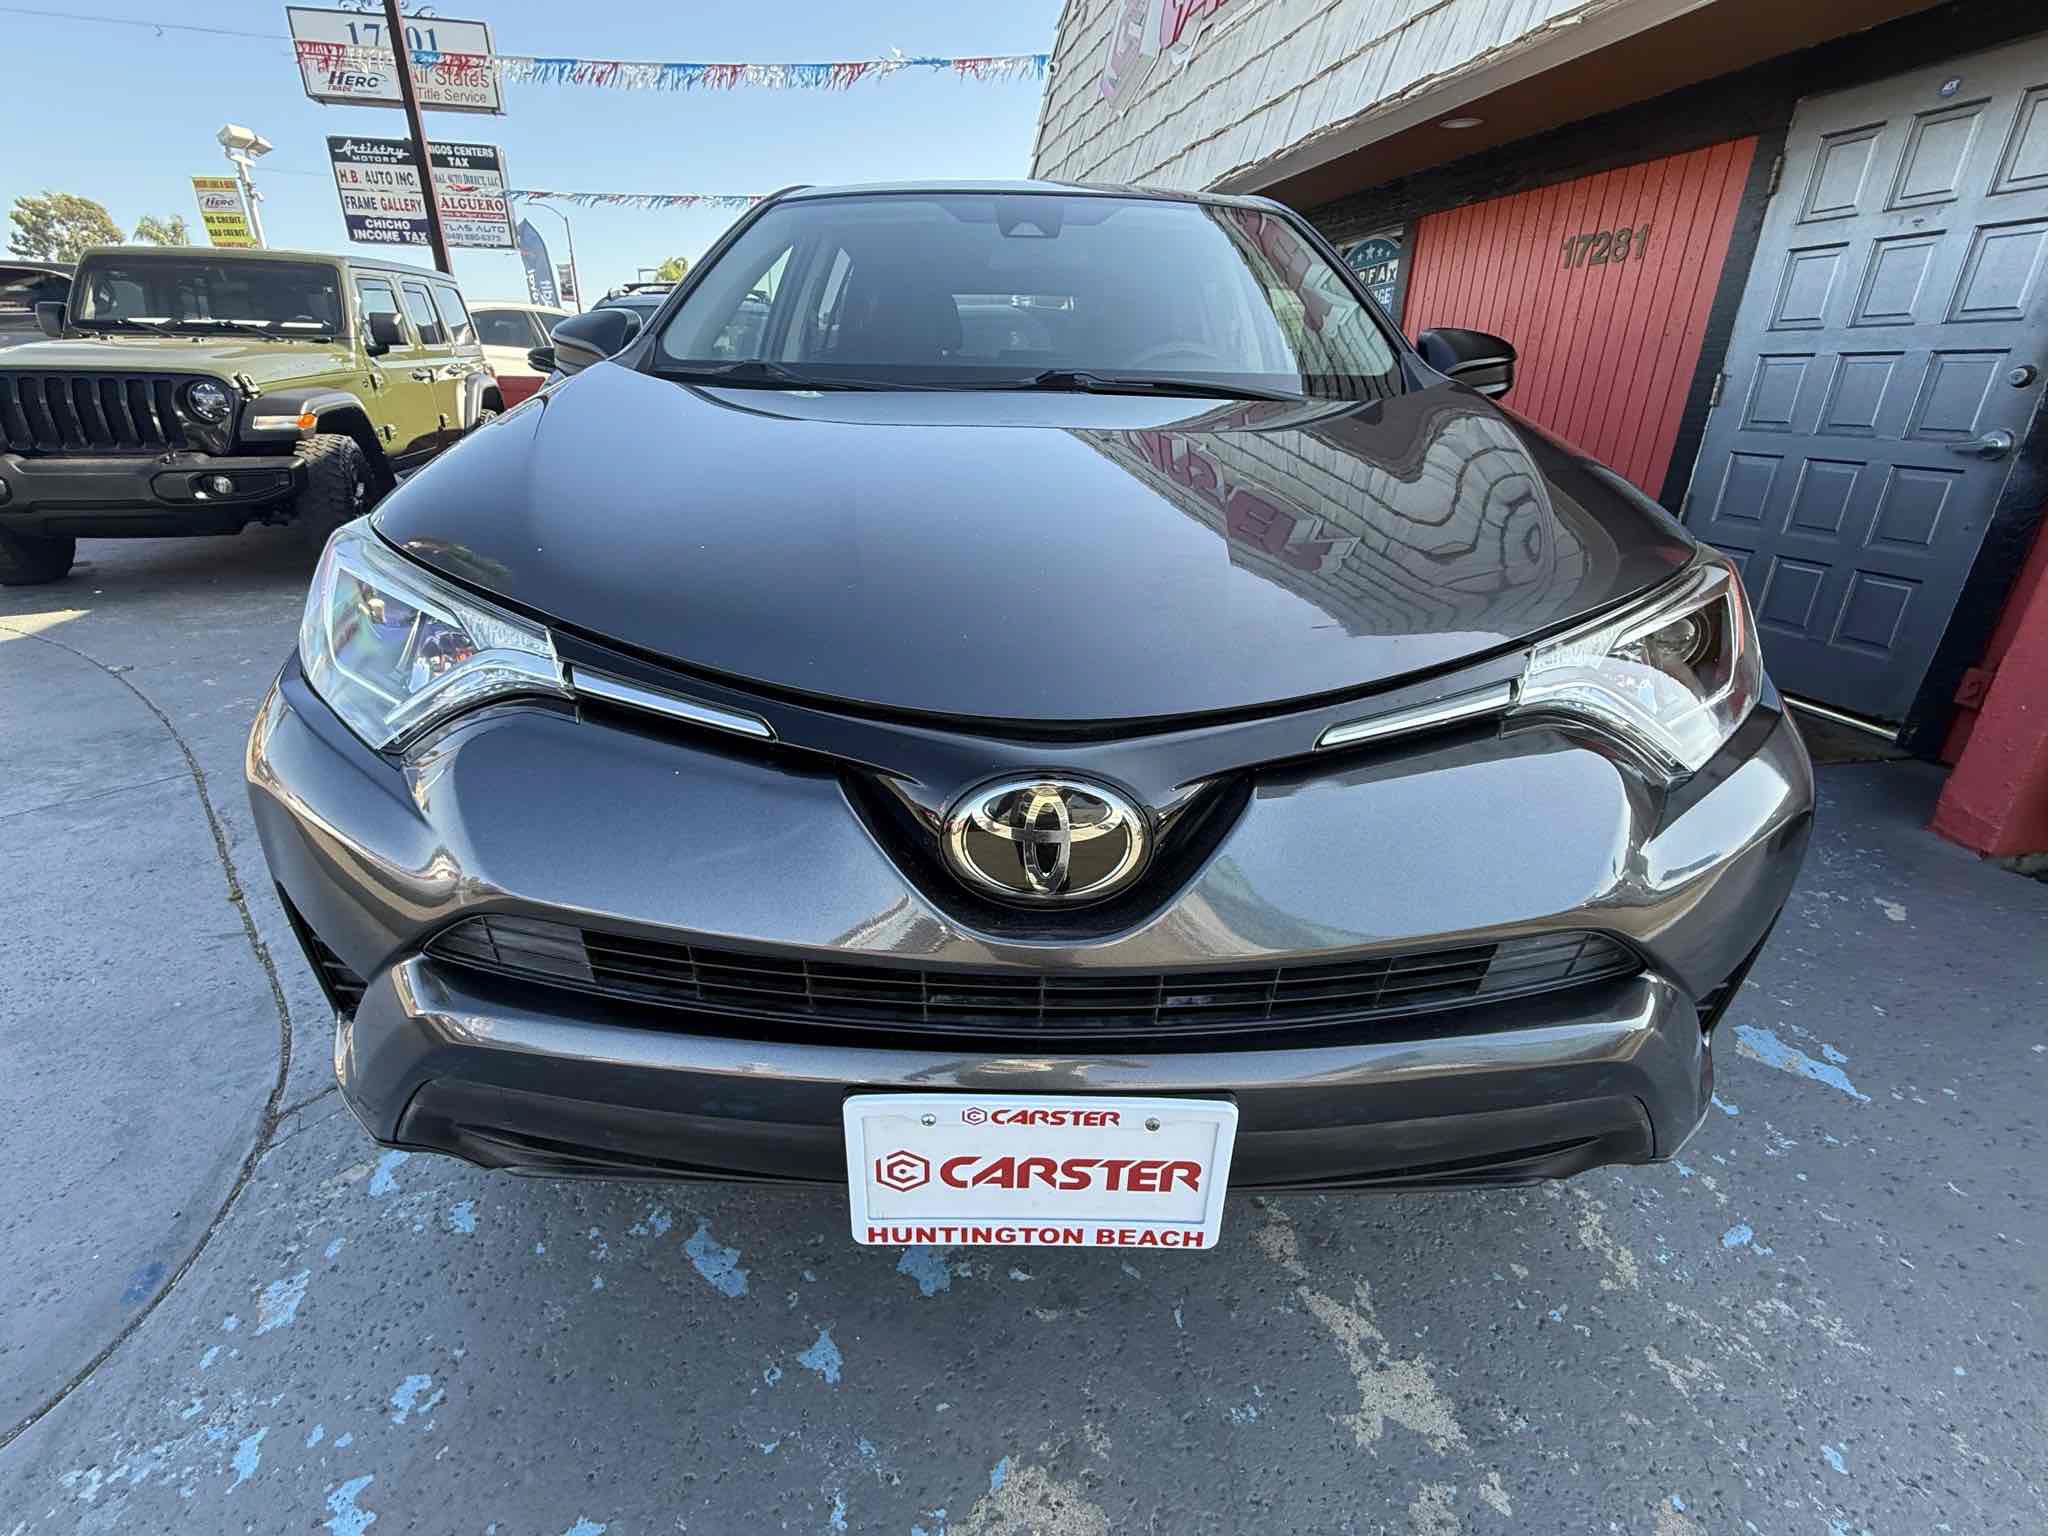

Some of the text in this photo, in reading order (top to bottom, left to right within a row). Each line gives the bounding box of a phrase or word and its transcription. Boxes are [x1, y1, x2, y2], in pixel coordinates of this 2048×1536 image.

[345, 21, 438, 51] 1701
[434, 66, 490, 88] States
[444, 88, 487, 103] Service
[335, 139, 410, 159] Artistry
[431, 145, 494, 158] IGOS CENTERS
[448, 157, 469, 167] TAX
[338, 168, 362, 184] H.B.
[365, 170, 393, 185] AUTO
[345, 195, 422, 213] FRAME GALLERY
[365, 219, 411, 230] CHICHO
[444, 224, 506, 233] TLAS AUTO
[352, 229, 428, 243] INCOME TAX
[1562, 223, 1649, 269] 17281
[991, 1108, 1122, 1127] CARSTER
[940, 1156, 1203, 1193] CARSTER
[867, 1226, 1205, 1248] HUNTINGTON BEACH
